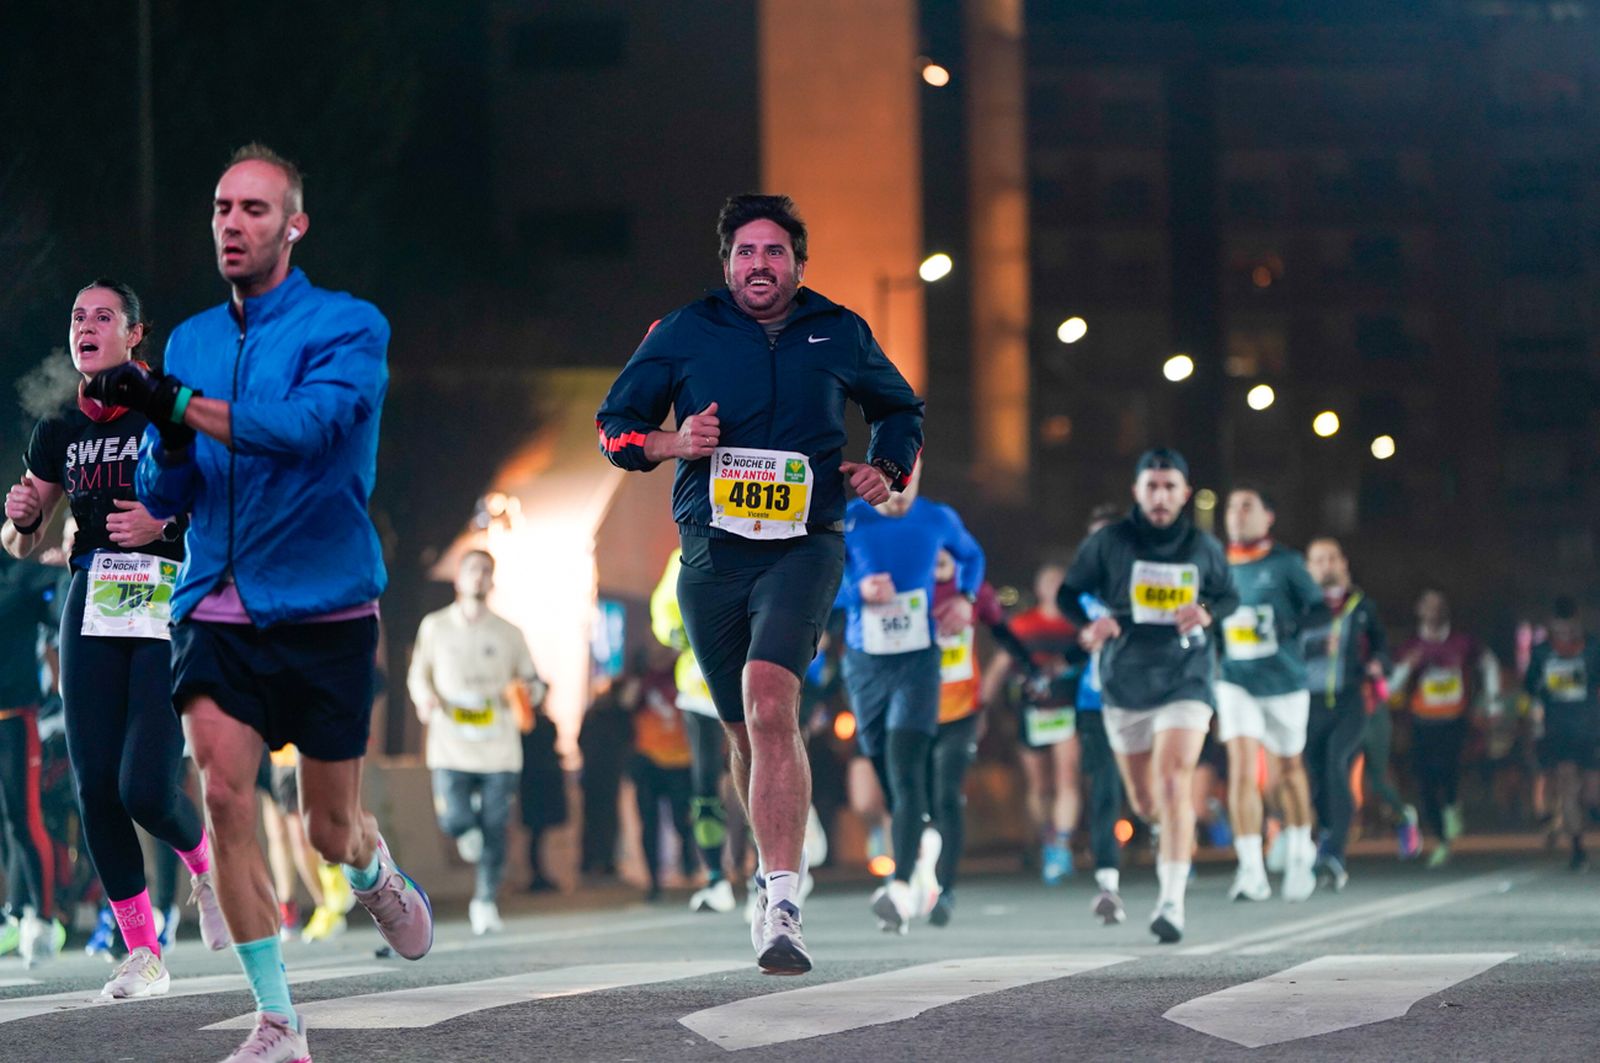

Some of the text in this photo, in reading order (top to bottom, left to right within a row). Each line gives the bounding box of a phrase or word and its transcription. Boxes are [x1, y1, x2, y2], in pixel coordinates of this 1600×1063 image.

[66, 435, 139, 468] SWEA
[733, 458, 777, 470] NOCHE DE
[66, 462, 132, 493] SMIL
[721, 468, 740, 479] SAN
[742, 469, 776, 481] ANTÓN
[728, 481, 791, 511] 4813
[748, 511, 770, 519] Vicente
[112, 562, 138, 572] NOCHE
[101, 574, 119, 582] SAN
[117, 583, 156, 608] 757
